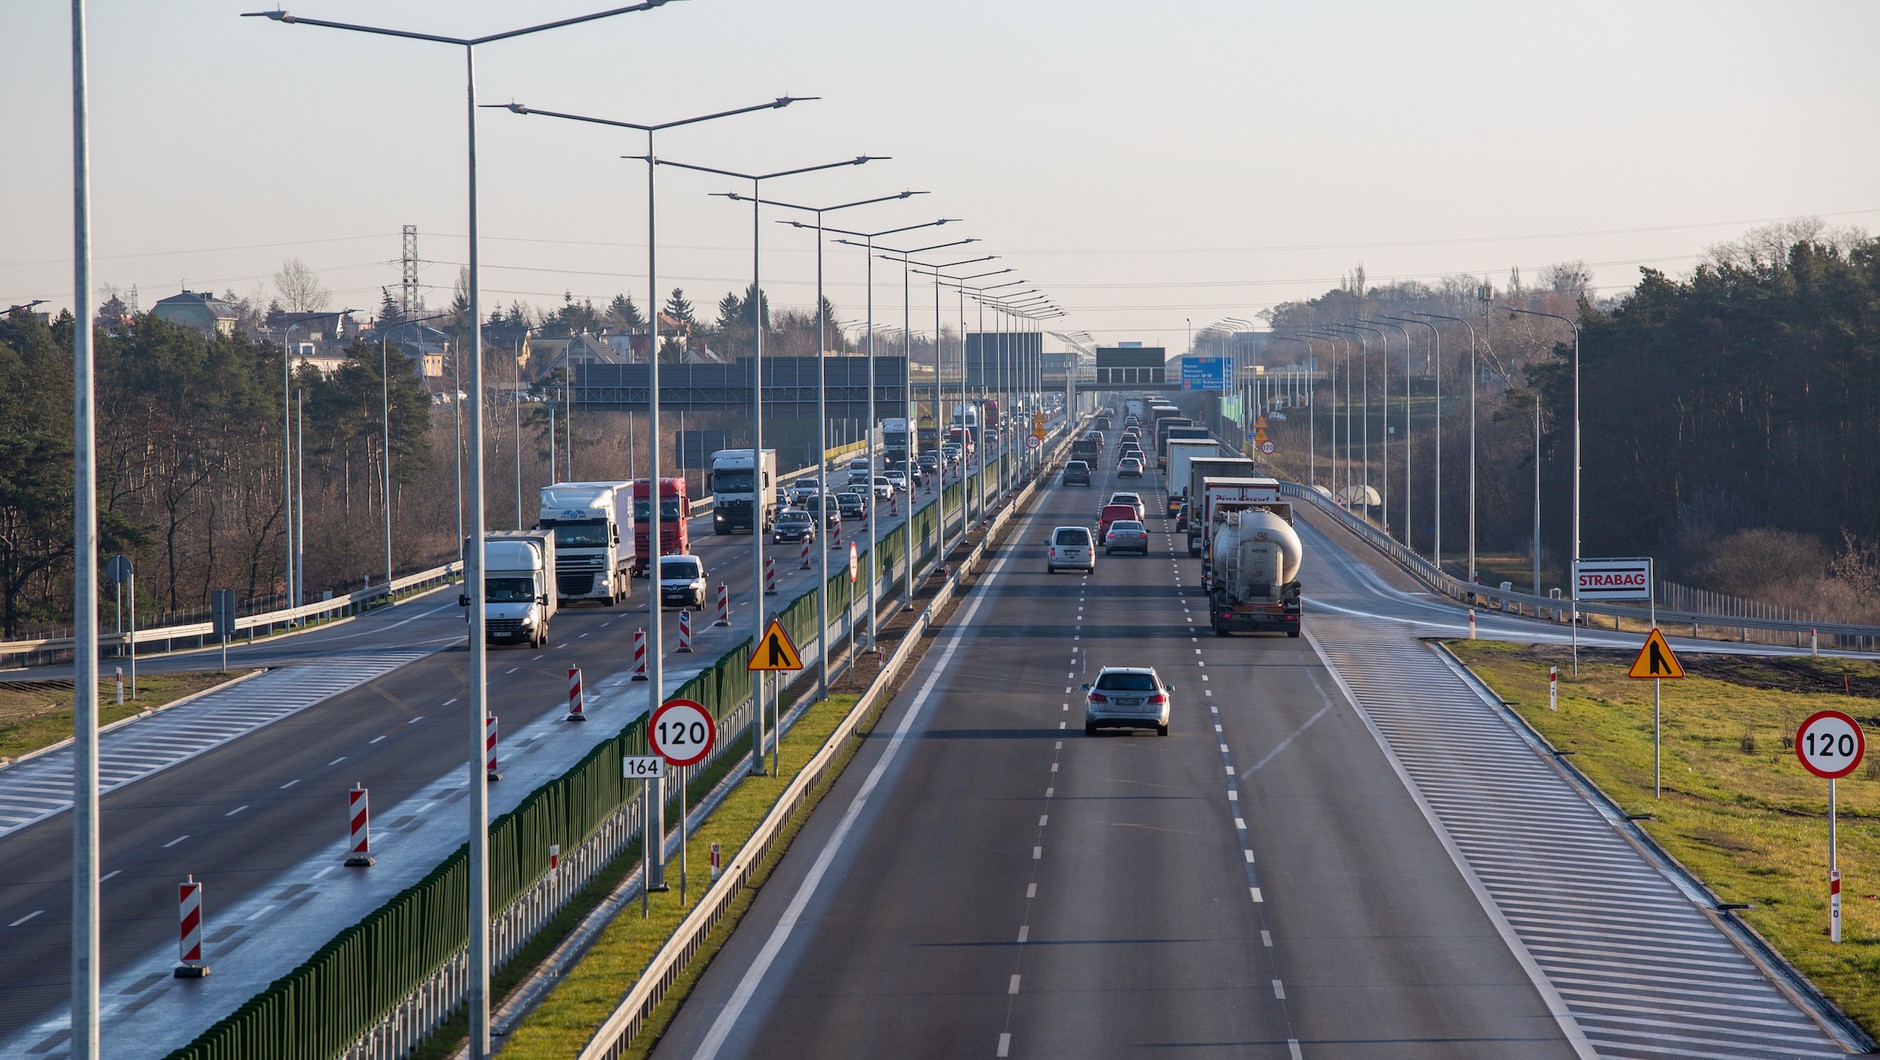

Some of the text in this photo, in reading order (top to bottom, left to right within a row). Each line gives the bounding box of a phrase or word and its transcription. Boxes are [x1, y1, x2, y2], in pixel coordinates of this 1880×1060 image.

[1579, 573, 1646, 587] STRABAG
[658, 721, 705, 745] 120
[1806, 732, 1855, 757] 120
[628, 759, 658, 775] 164
[1833, 910, 1839, 918] 0
